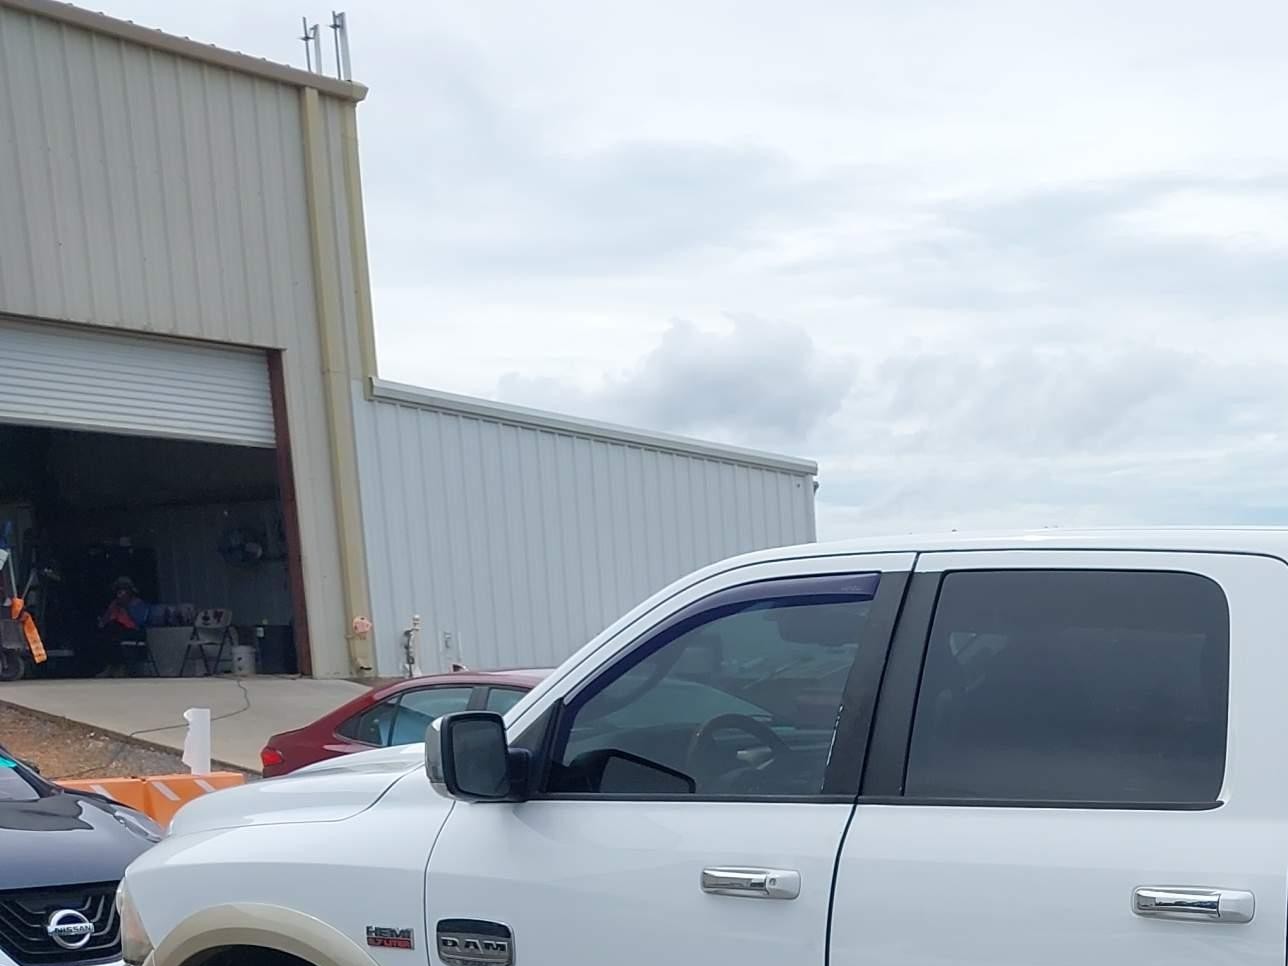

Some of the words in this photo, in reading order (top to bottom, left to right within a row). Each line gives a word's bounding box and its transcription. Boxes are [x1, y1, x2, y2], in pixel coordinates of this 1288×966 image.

[55, 925, 91, 934] NISSAN
[366, 926, 412, 938] HEMI
[440, 936, 508, 954] RAM
